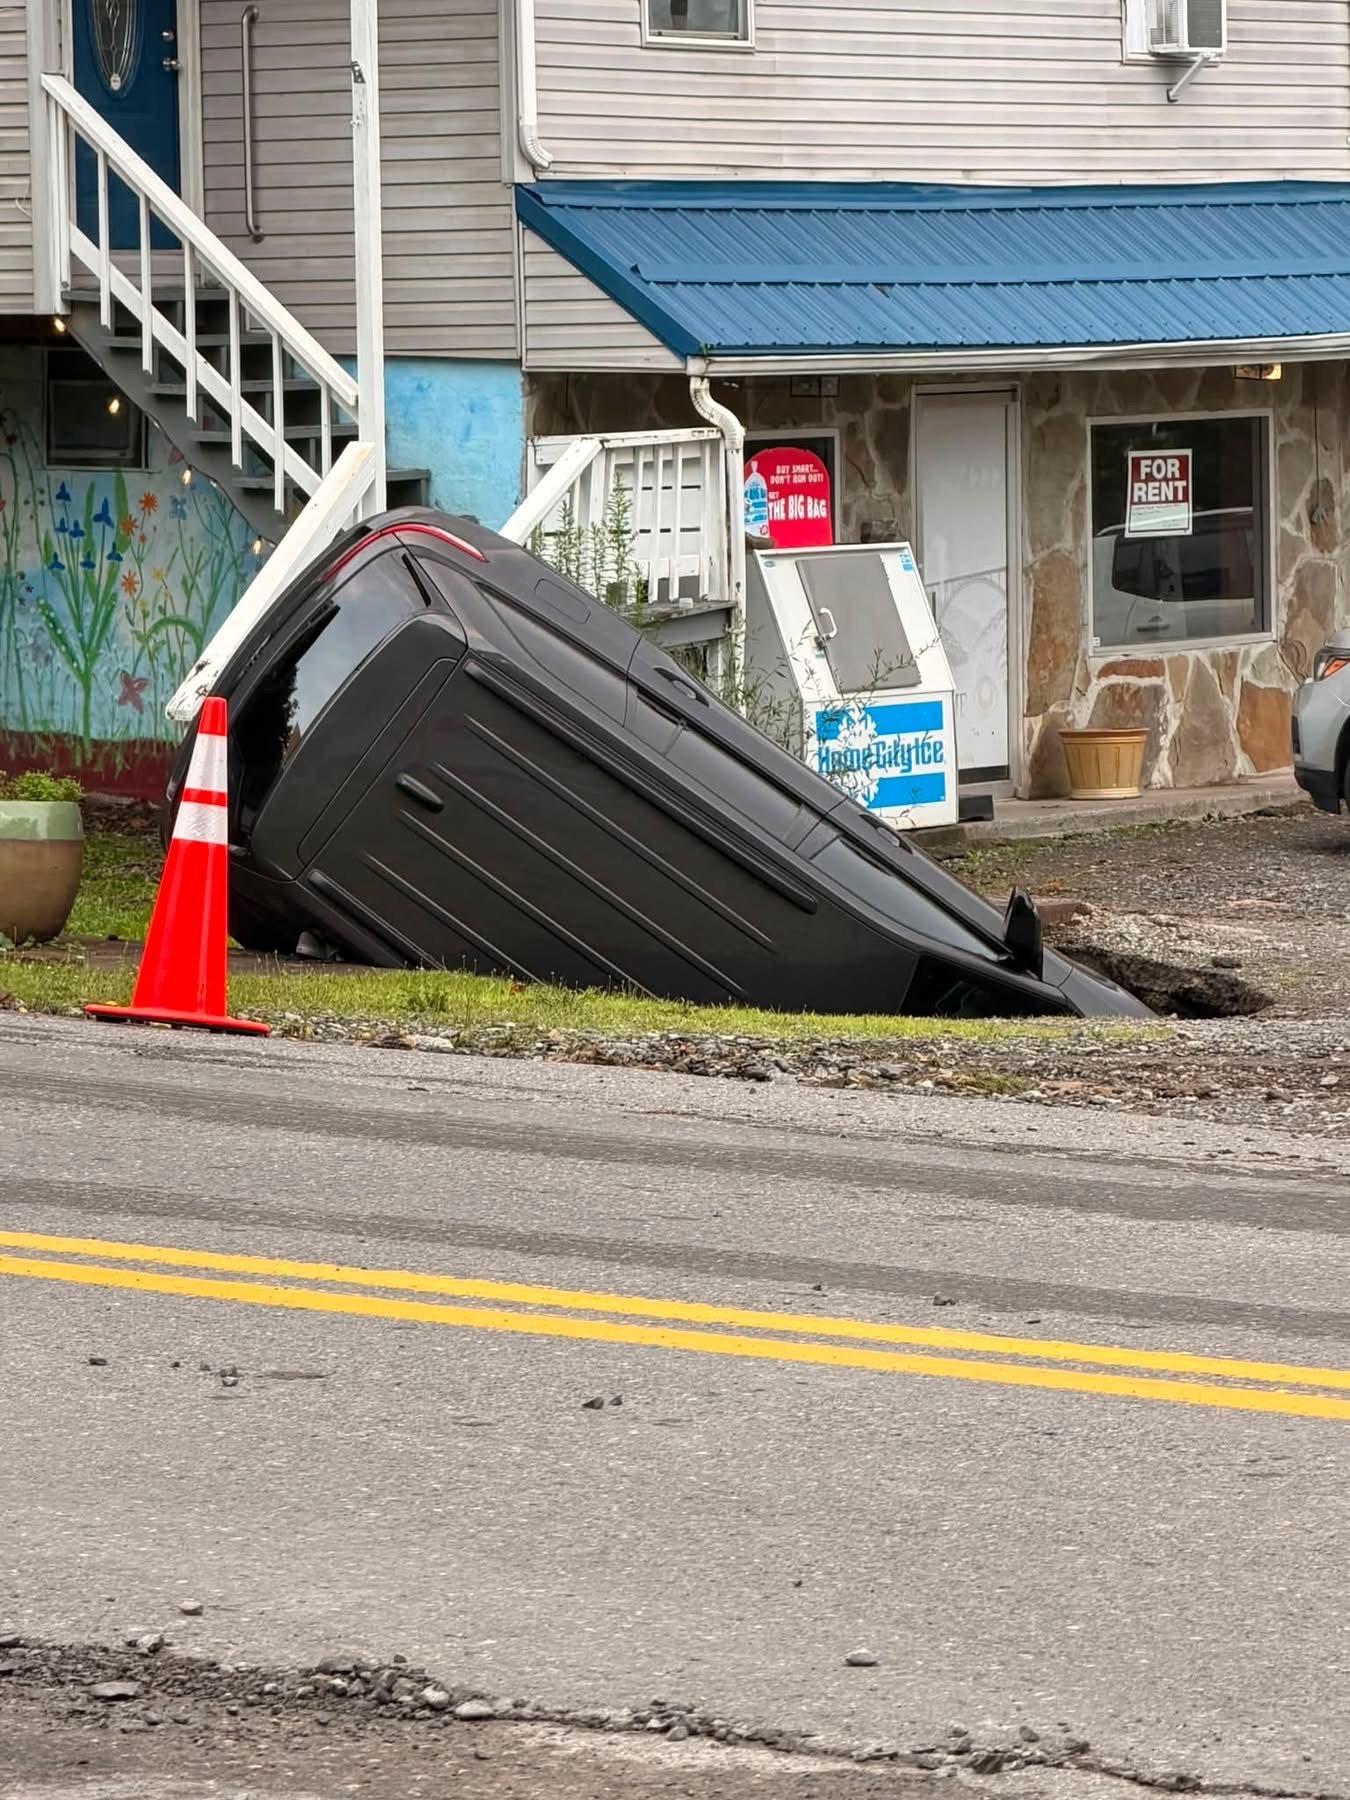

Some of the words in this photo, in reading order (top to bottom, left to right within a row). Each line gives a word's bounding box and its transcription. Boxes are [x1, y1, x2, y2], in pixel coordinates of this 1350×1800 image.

[1140, 458, 1180, 480] FOR
[1133, 480, 1187, 502] RENT
[768, 498, 786, 520] THE
[788, 494, 804, 520] BIG
[806, 496, 827, 519] BAG
